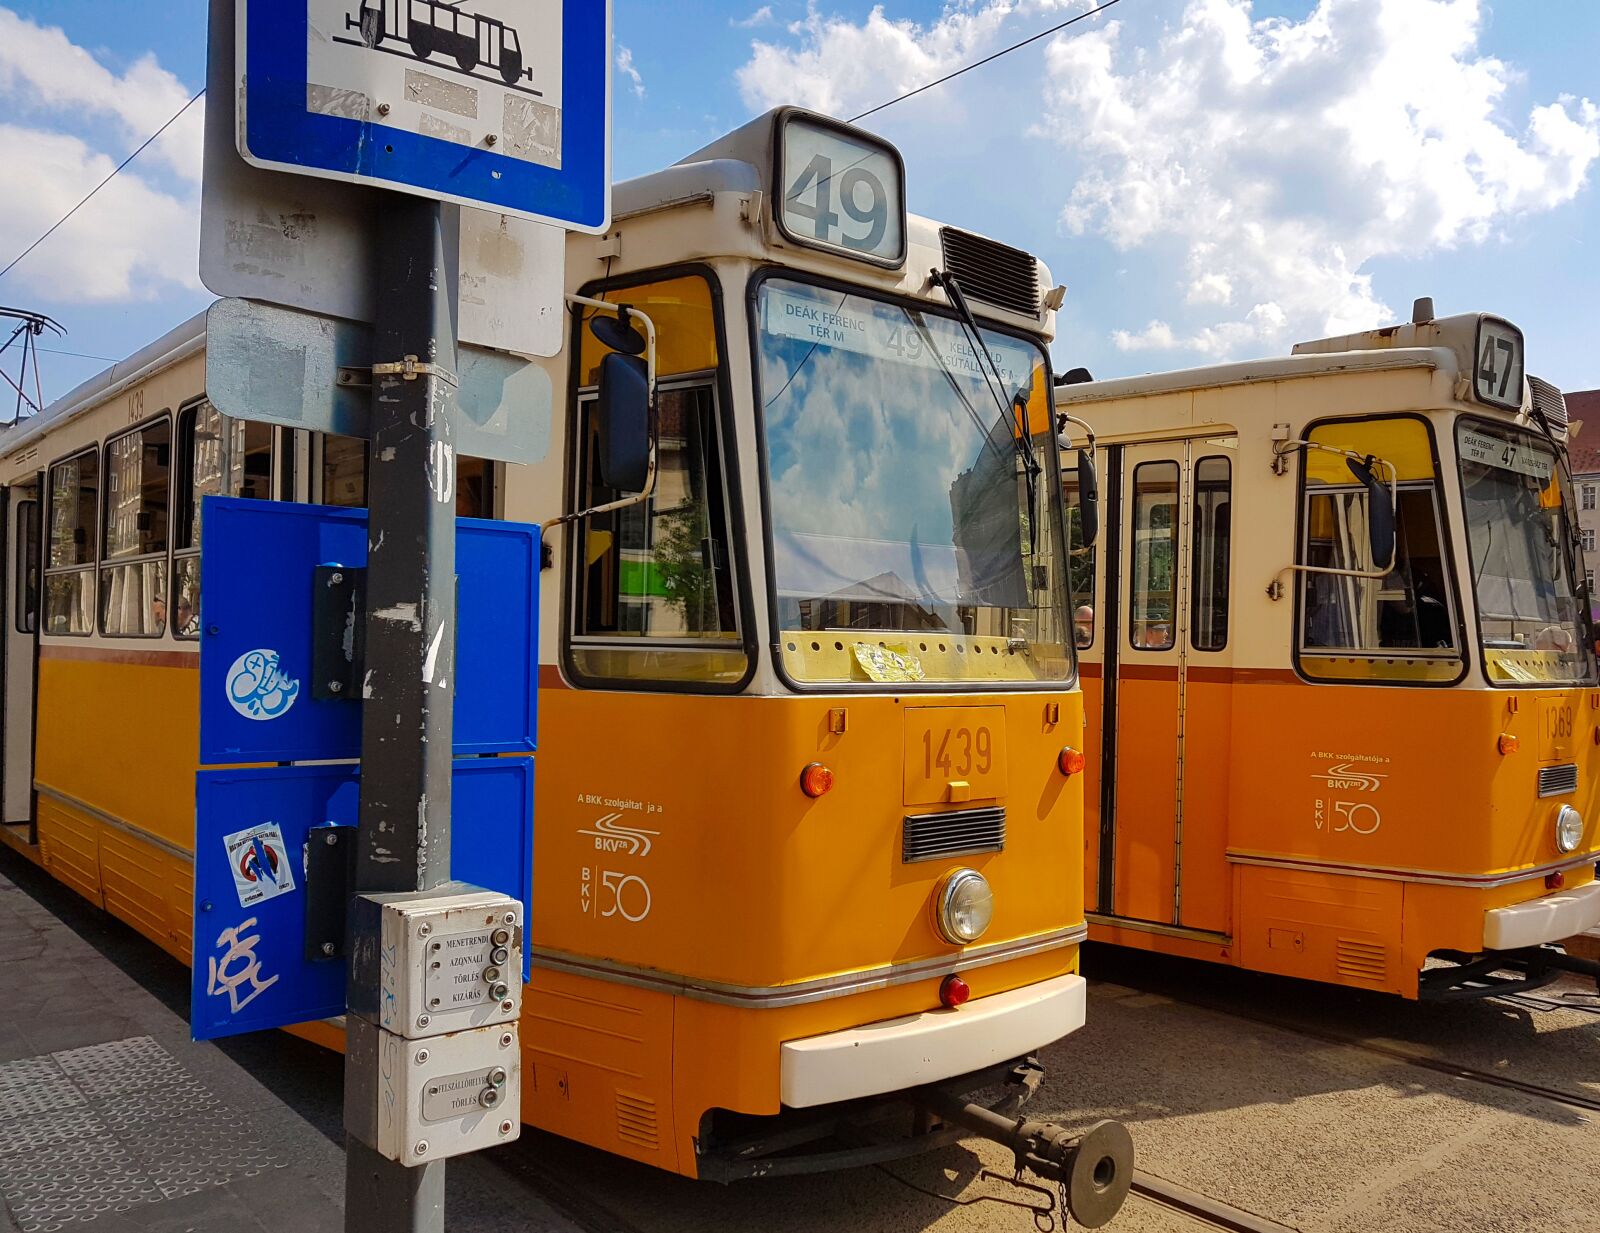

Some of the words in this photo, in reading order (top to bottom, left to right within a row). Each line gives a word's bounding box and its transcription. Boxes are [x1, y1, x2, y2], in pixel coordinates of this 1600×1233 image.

[785, 153, 888, 251] 49
[785, 303, 819, 321] DEÁK
[822, 312, 865, 332] FERENC
[808, 323, 830, 339] TÉR
[834, 330, 844, 342] M
[886, 325, 923, 360] 49
[1479, 335, 1514, 397] 47
[128, 389, 144, 424] 1439
[1502, 446, 1517, 467] 47
[1546, 705, 1572, 739] 1369
[923, 726, 992, 779] 1439
[1318, 751, 1334, 759] BKK
[1335, 753, 1383, 764] szolgáltatója
[577, 793, 584, 803] A
[585, 794, 602, 805] BKK
[657, 805, 663, 813] a
[1315, 799, 1324, 830] BKV
[1334, 801, 1380, 834] 50
[581, 867, 591, 913] BKV
[601, 870, 651, 922] 50
[446, 935, 489, 948] MENETRENDI
[450, 954, 483, 967] AZONNALI
[452, 988, 481, 1002] KIZÁRÁS
